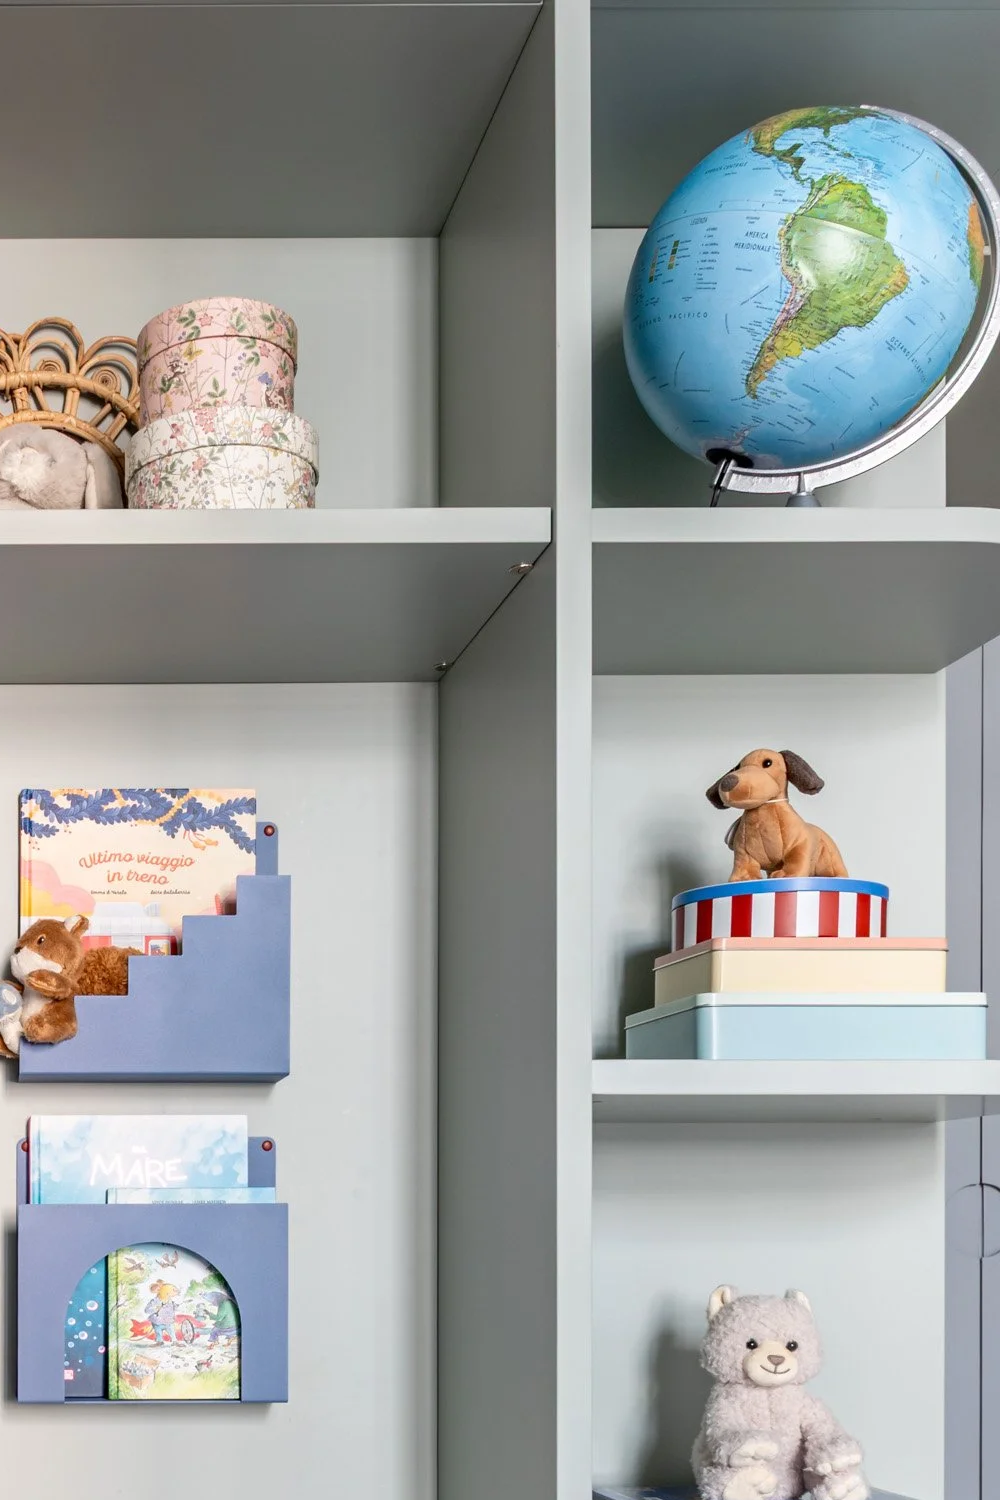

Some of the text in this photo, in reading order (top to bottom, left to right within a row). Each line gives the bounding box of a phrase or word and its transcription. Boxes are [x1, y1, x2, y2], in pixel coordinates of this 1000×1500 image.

[744, 231, 769, 239] AMERICA
[734, 243, 771, 252] MERIDIONALE
[669, 311, 708, 320] PACIFICO
[78, 850, 196, 872] Ultimo viaggio
[107, 869, 170, 885] in treno
[89, 1153, 188, 1187] MARE
